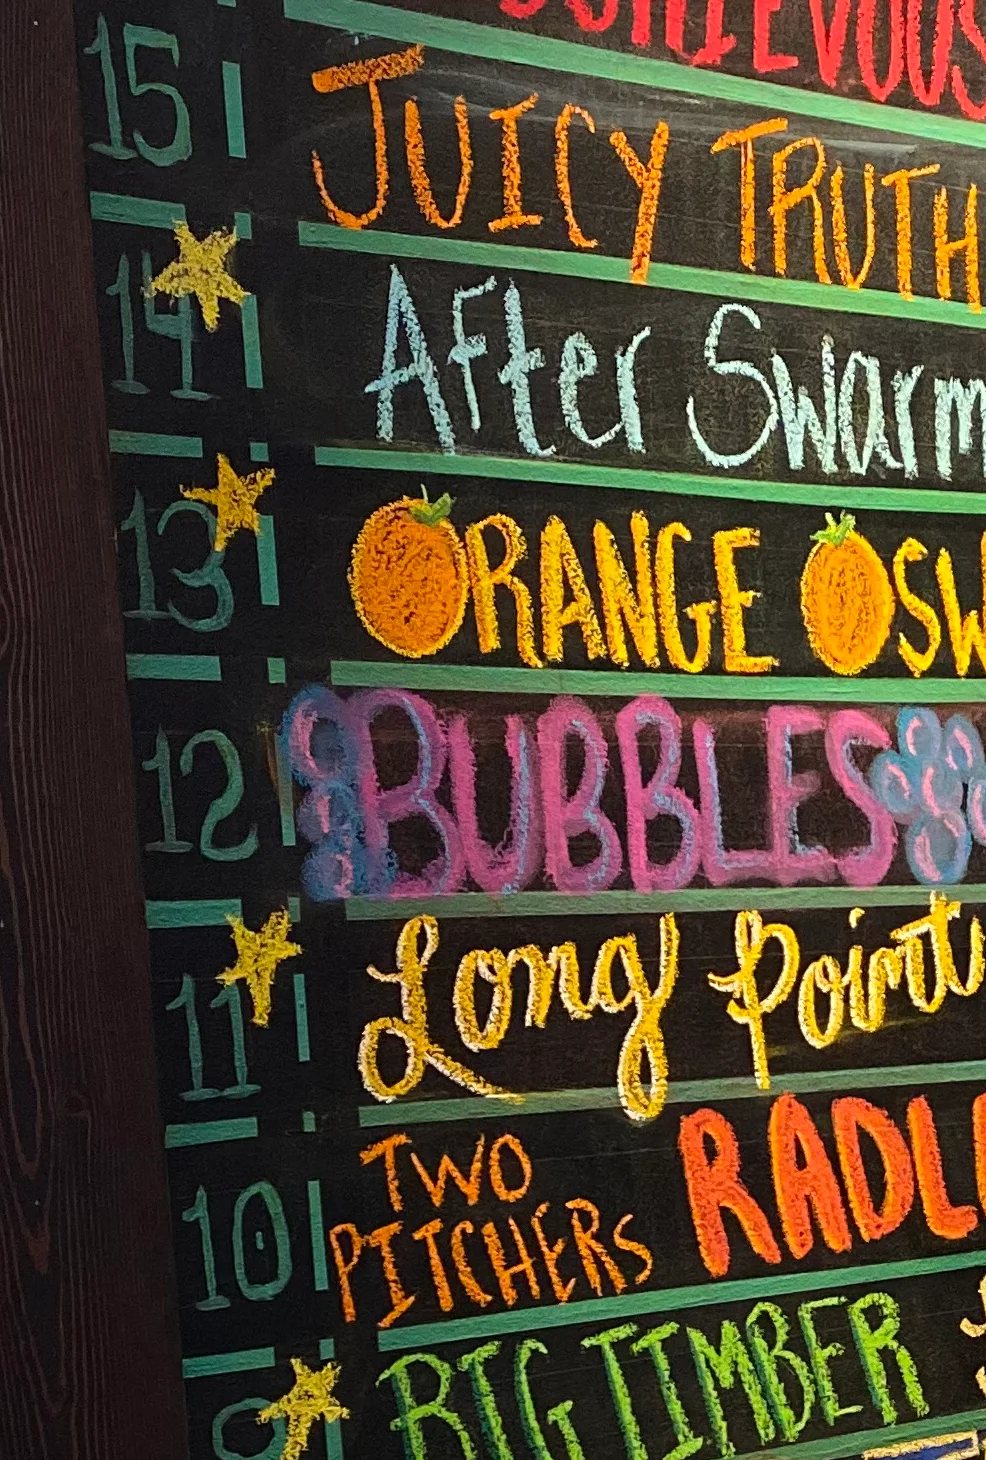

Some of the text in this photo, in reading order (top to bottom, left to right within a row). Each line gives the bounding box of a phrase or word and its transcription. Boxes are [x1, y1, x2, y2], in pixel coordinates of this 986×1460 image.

[84, 13, 193, 167] 15
[311, 45, 984, 314] JUICY TRUTH
[106, 249, 212, 400] 14
[364, 263, 652, 456] After
[121, 487, 234, 632] 13
[142, 724, 260, 861] 12
[342, 686, 898, 899] BUBBLES
[166, 973, 263, 1100] 11
[357, 912, 680, 1121] Long
[708, 890, 986, 1089] Point
[181, 1180, 292, 1311] 10
[360, 1131, 532, 1213] TWO
[330, 1198, 654, 1328] PITCHERS
